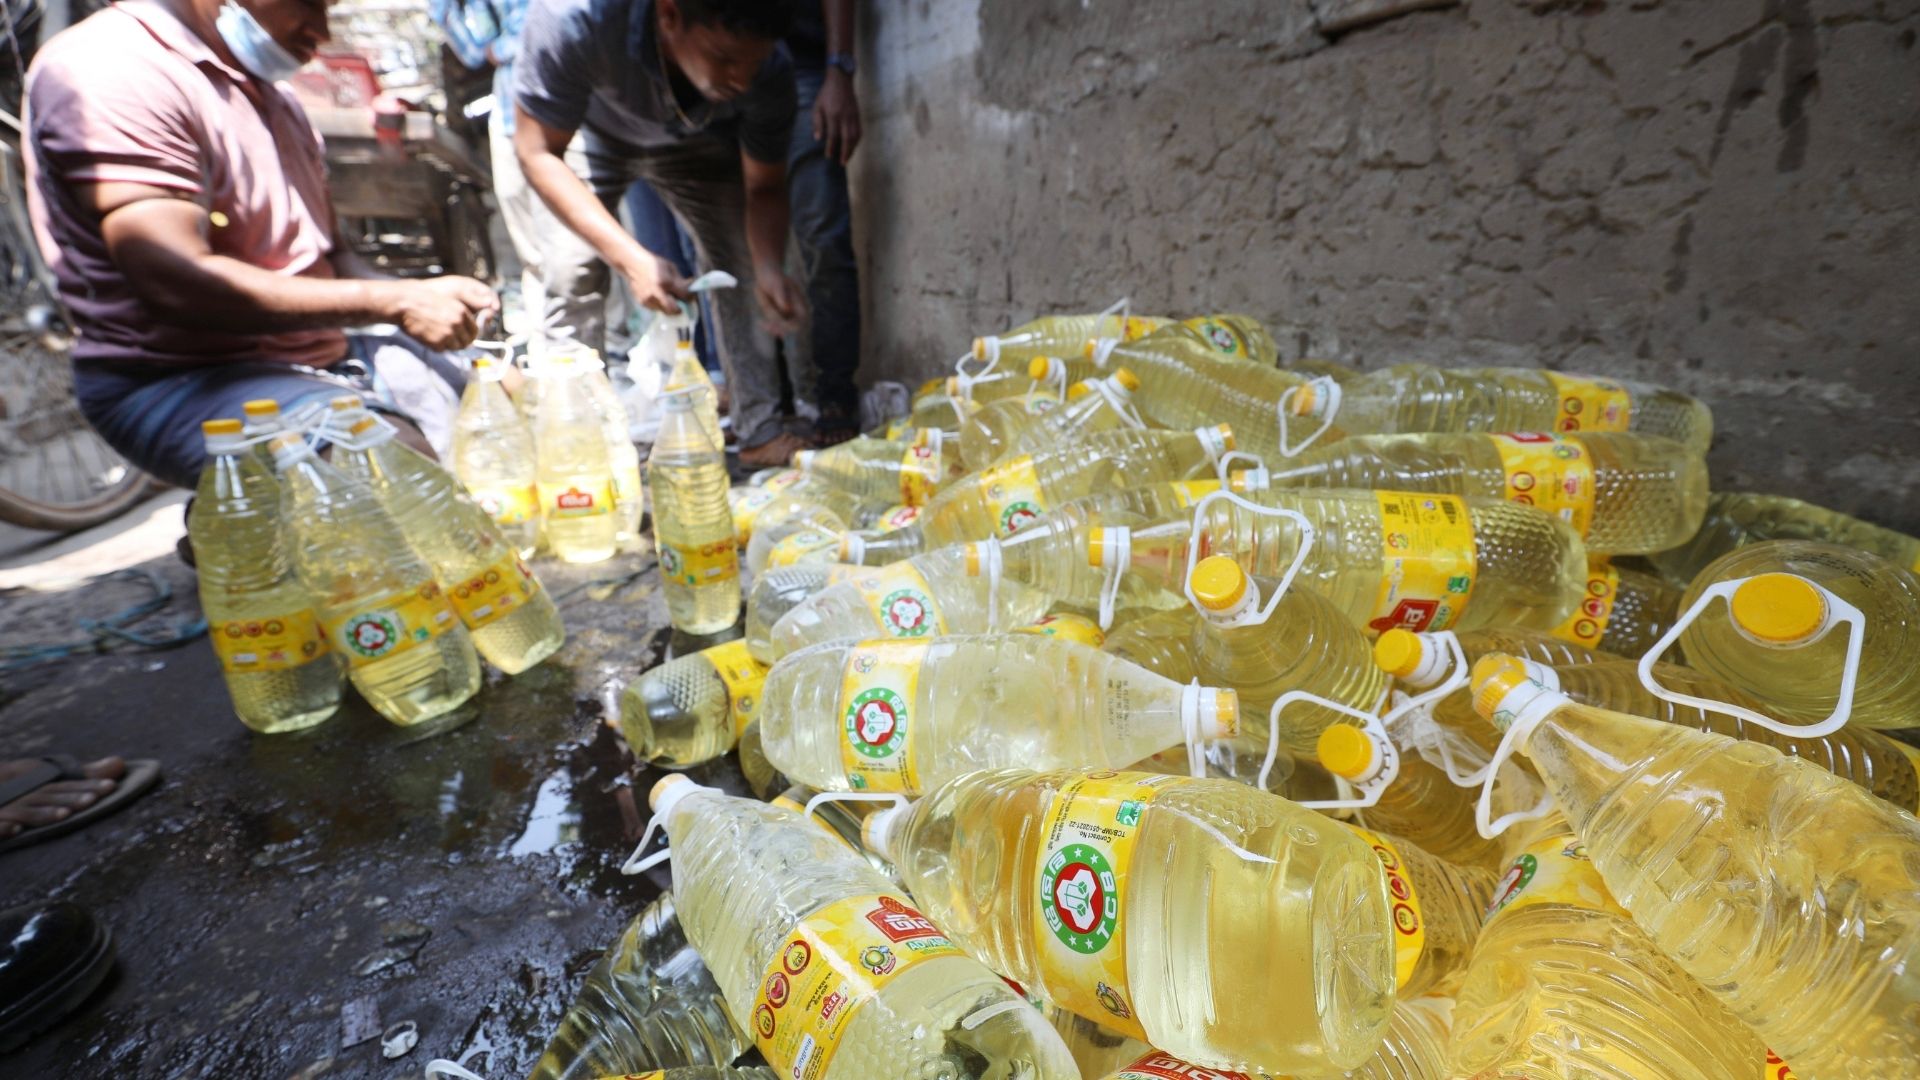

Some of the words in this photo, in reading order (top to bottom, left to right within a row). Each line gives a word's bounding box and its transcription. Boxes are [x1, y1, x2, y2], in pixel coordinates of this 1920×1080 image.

[1087, 832, 1112, 843] Contract
[1097, 871, 1117, 940] TCB
[822, 994, 840, 1017] TEER
[797, 1038, 812, 1069] citygroup
